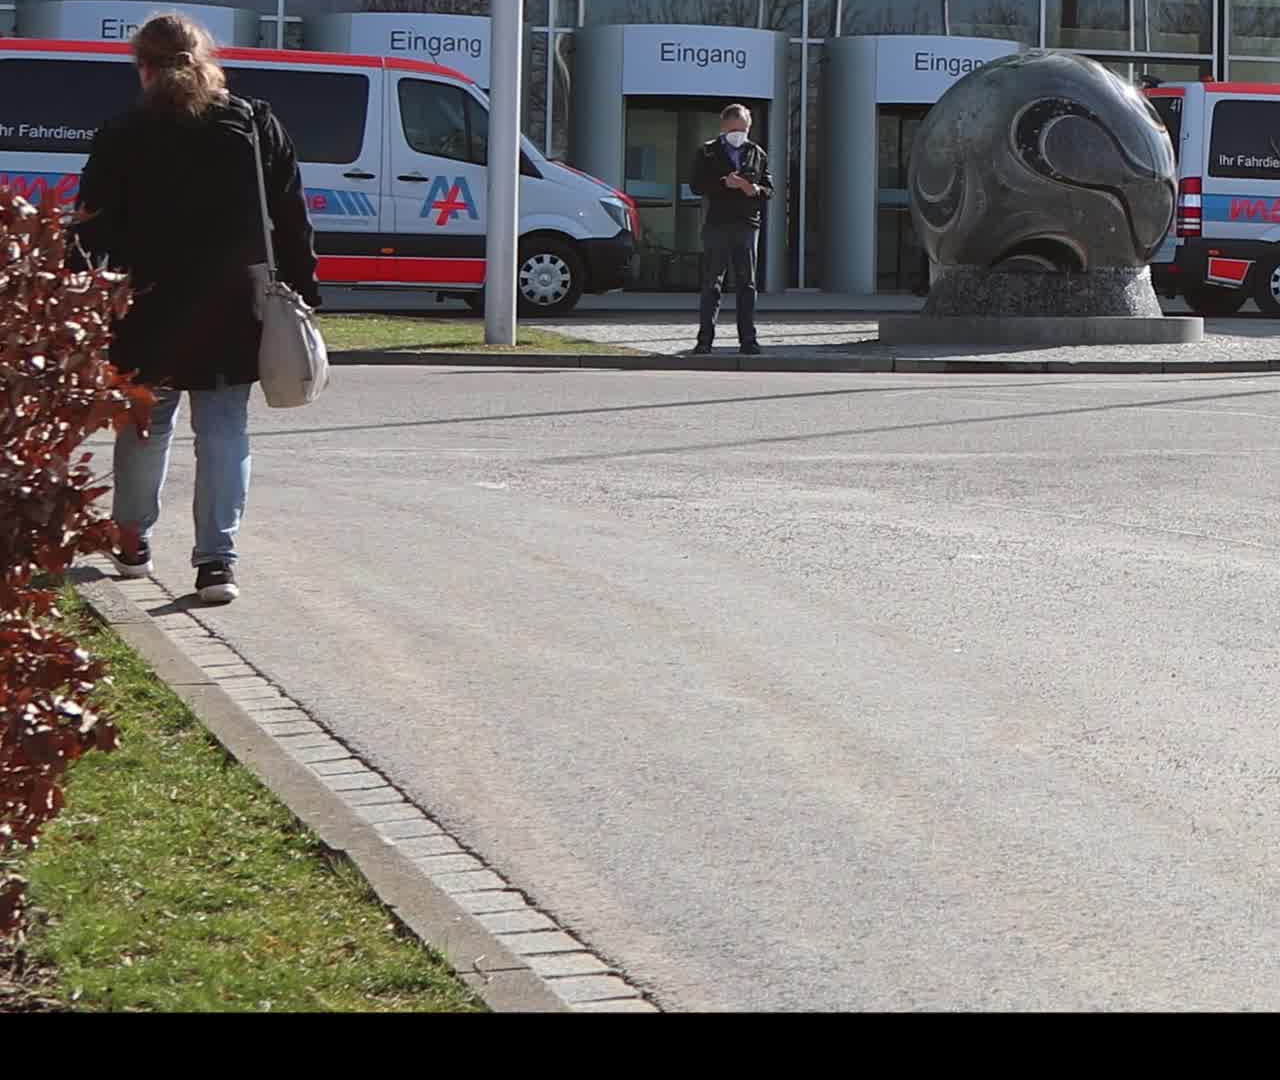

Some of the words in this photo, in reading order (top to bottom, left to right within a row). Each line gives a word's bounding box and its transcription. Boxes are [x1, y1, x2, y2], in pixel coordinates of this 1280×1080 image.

[390, 30, 482, 58] Eingang
[660, 42, 747, 69] Eingang
[0, 124, 14, 137] hr
[19, 124, 99, 140] Fahrdiens
[1218, 154, 1235, 166] Ihr
